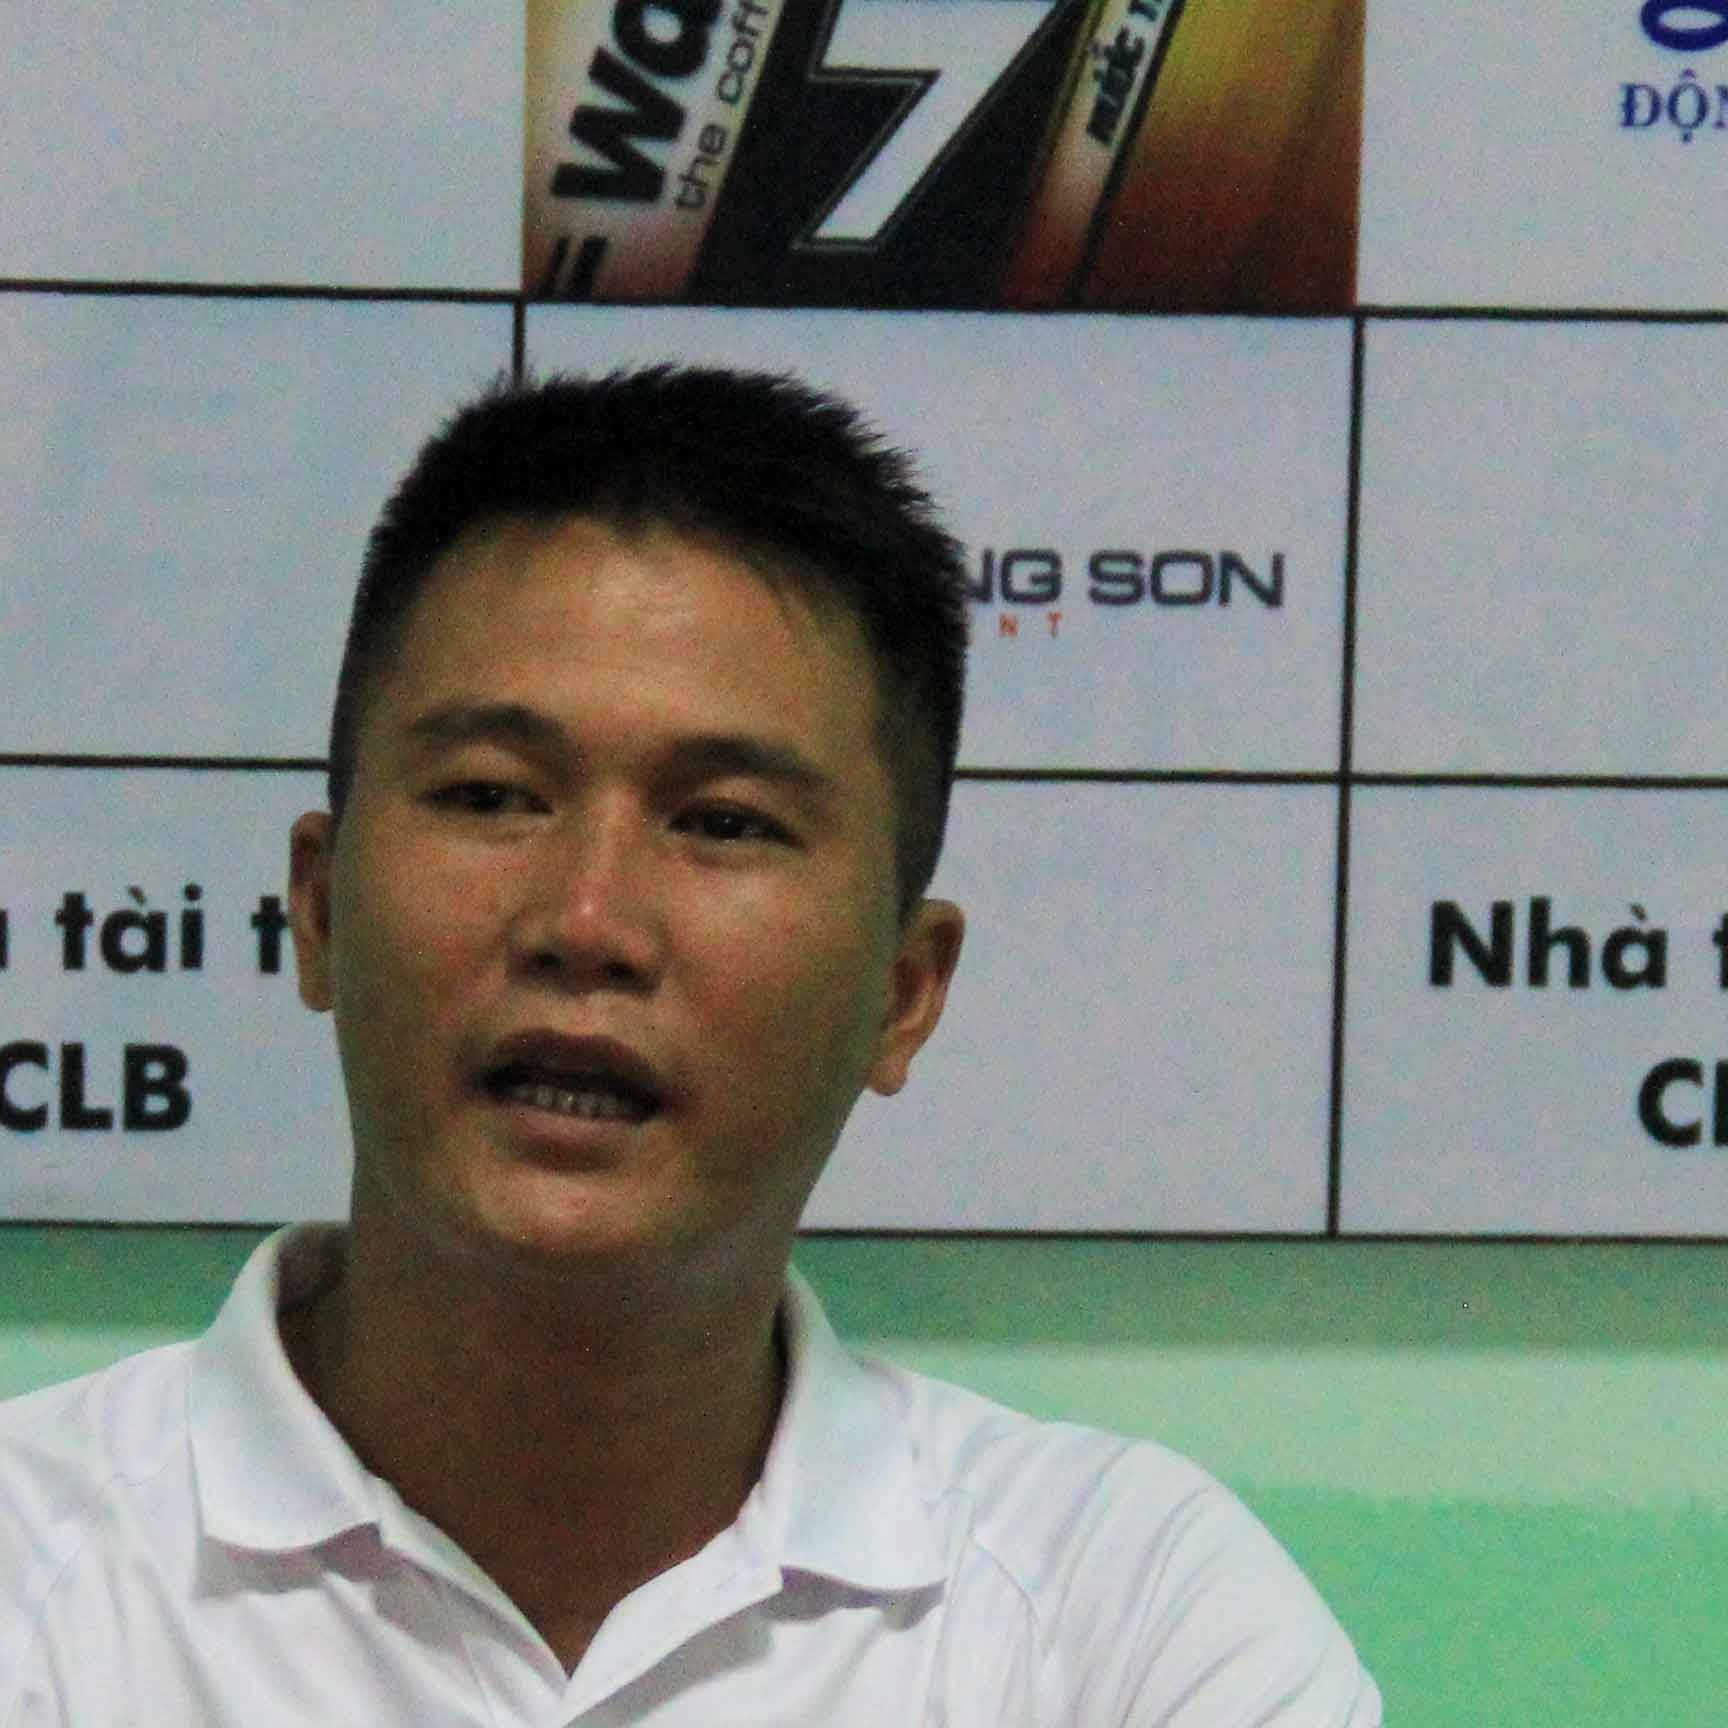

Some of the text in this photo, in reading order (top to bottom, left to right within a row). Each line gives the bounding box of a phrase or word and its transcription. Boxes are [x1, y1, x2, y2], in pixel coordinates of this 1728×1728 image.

[675, 123, 728, 209] the
[1089, 551, 1284, 608] SON
[55, 883, 204, 974] tài
[1429, 897, 1668, 990] Nhà
